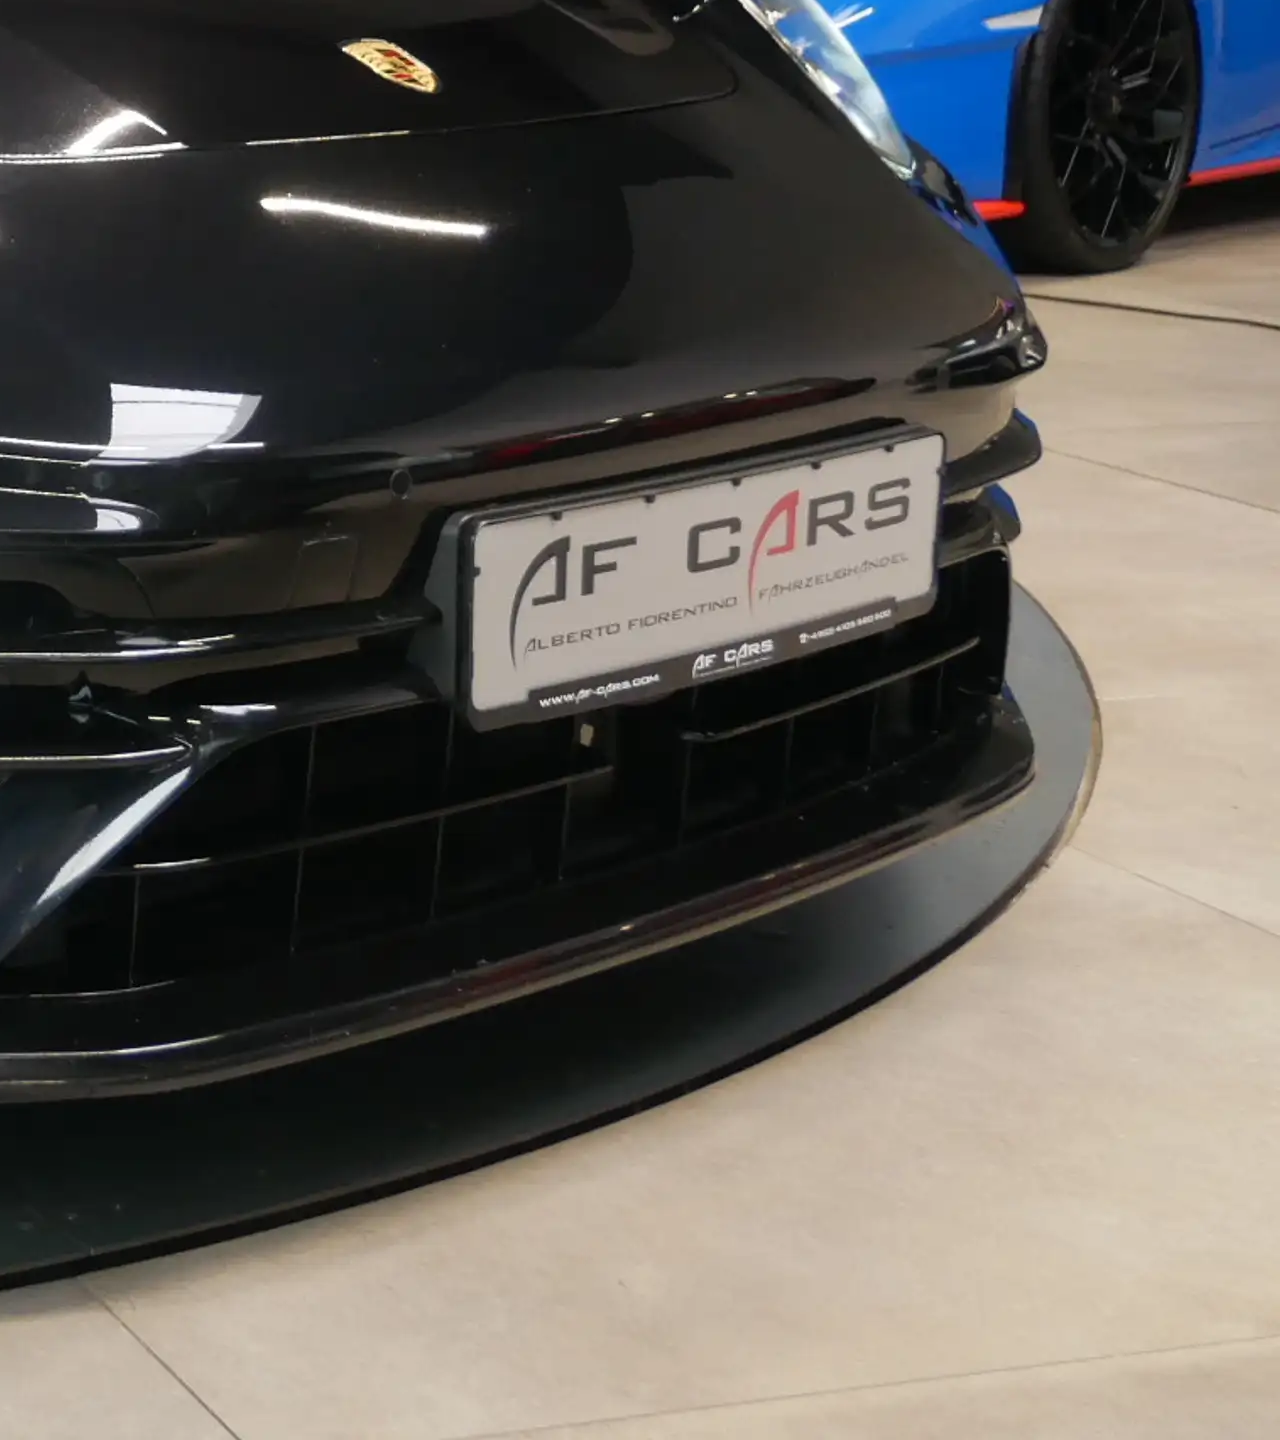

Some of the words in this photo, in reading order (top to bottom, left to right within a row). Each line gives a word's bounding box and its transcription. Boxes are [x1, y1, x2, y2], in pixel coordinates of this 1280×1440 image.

[509, 534, 638, 671] AF
[686, 477, 912, 615] CARS
[523, 622, 621, 660] ALBERTO
[627, 596, 738, 631] FIORENTINO
[758, 552, 909, 603] FAHRZEUGHANDEL
[692, 653, 717, 679] AF
[723, 638, 774, 668] CARS
